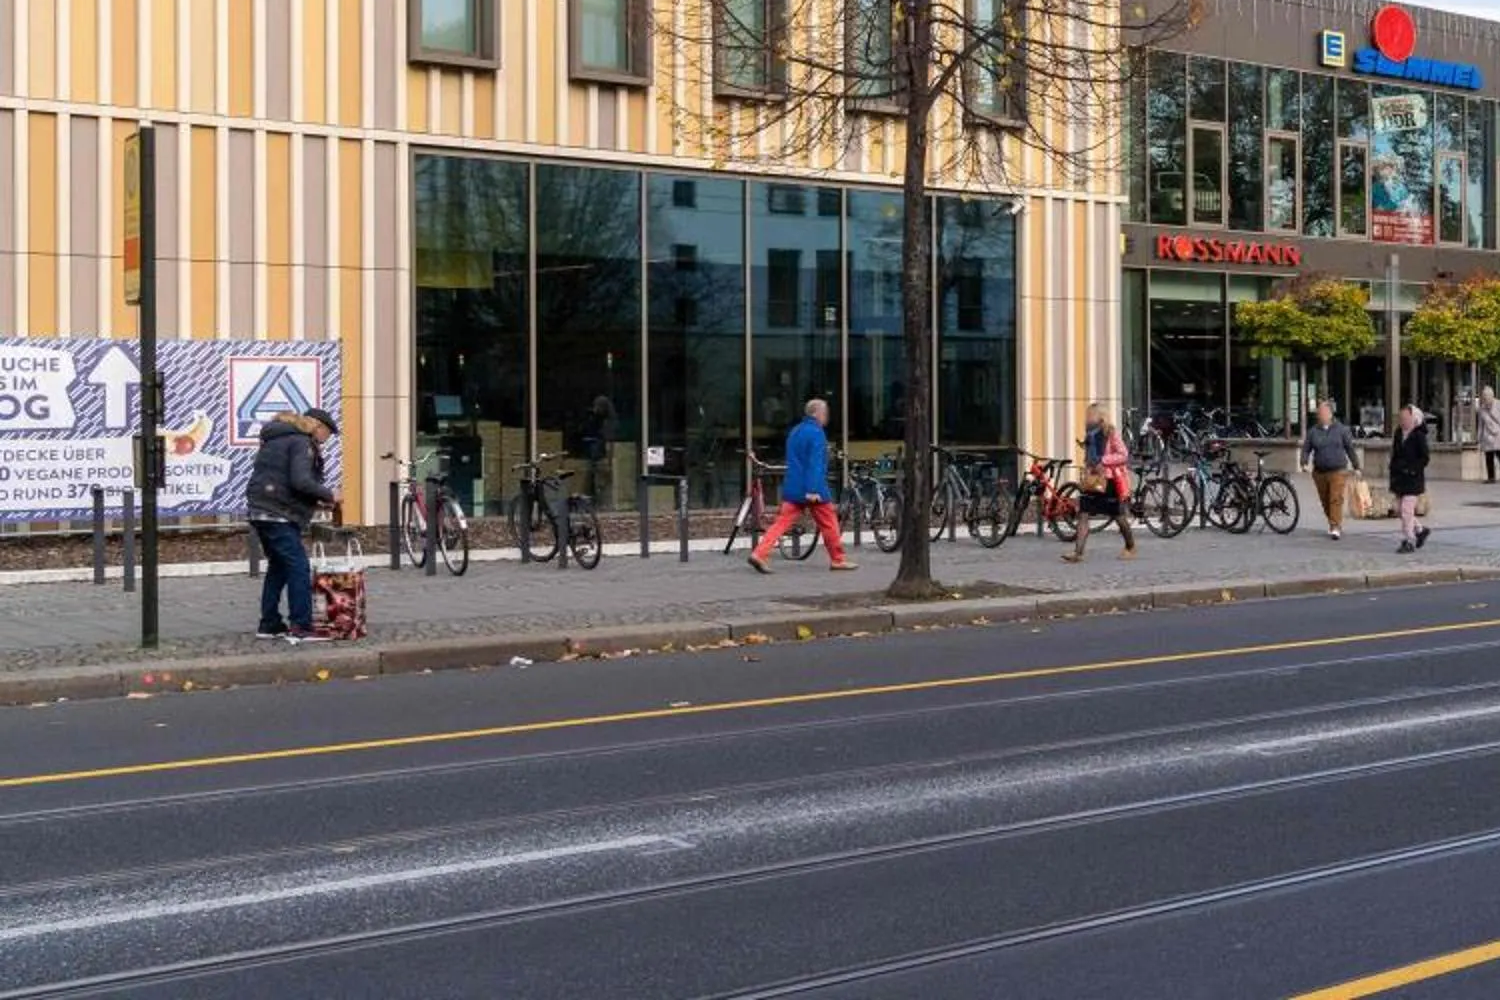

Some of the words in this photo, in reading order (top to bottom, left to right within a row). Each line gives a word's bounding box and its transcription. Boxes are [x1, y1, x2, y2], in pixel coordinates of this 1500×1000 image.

[1156, 232, 1301, 266] ROSSMANN
[13, 376, 38, 391] IM
[0, 448, 61, 462] DECKE
[63, 445, 106, 461] ÜBER
[14, 467, 84, 481] VEGANE
[13, 488, 63, 500] RUND
